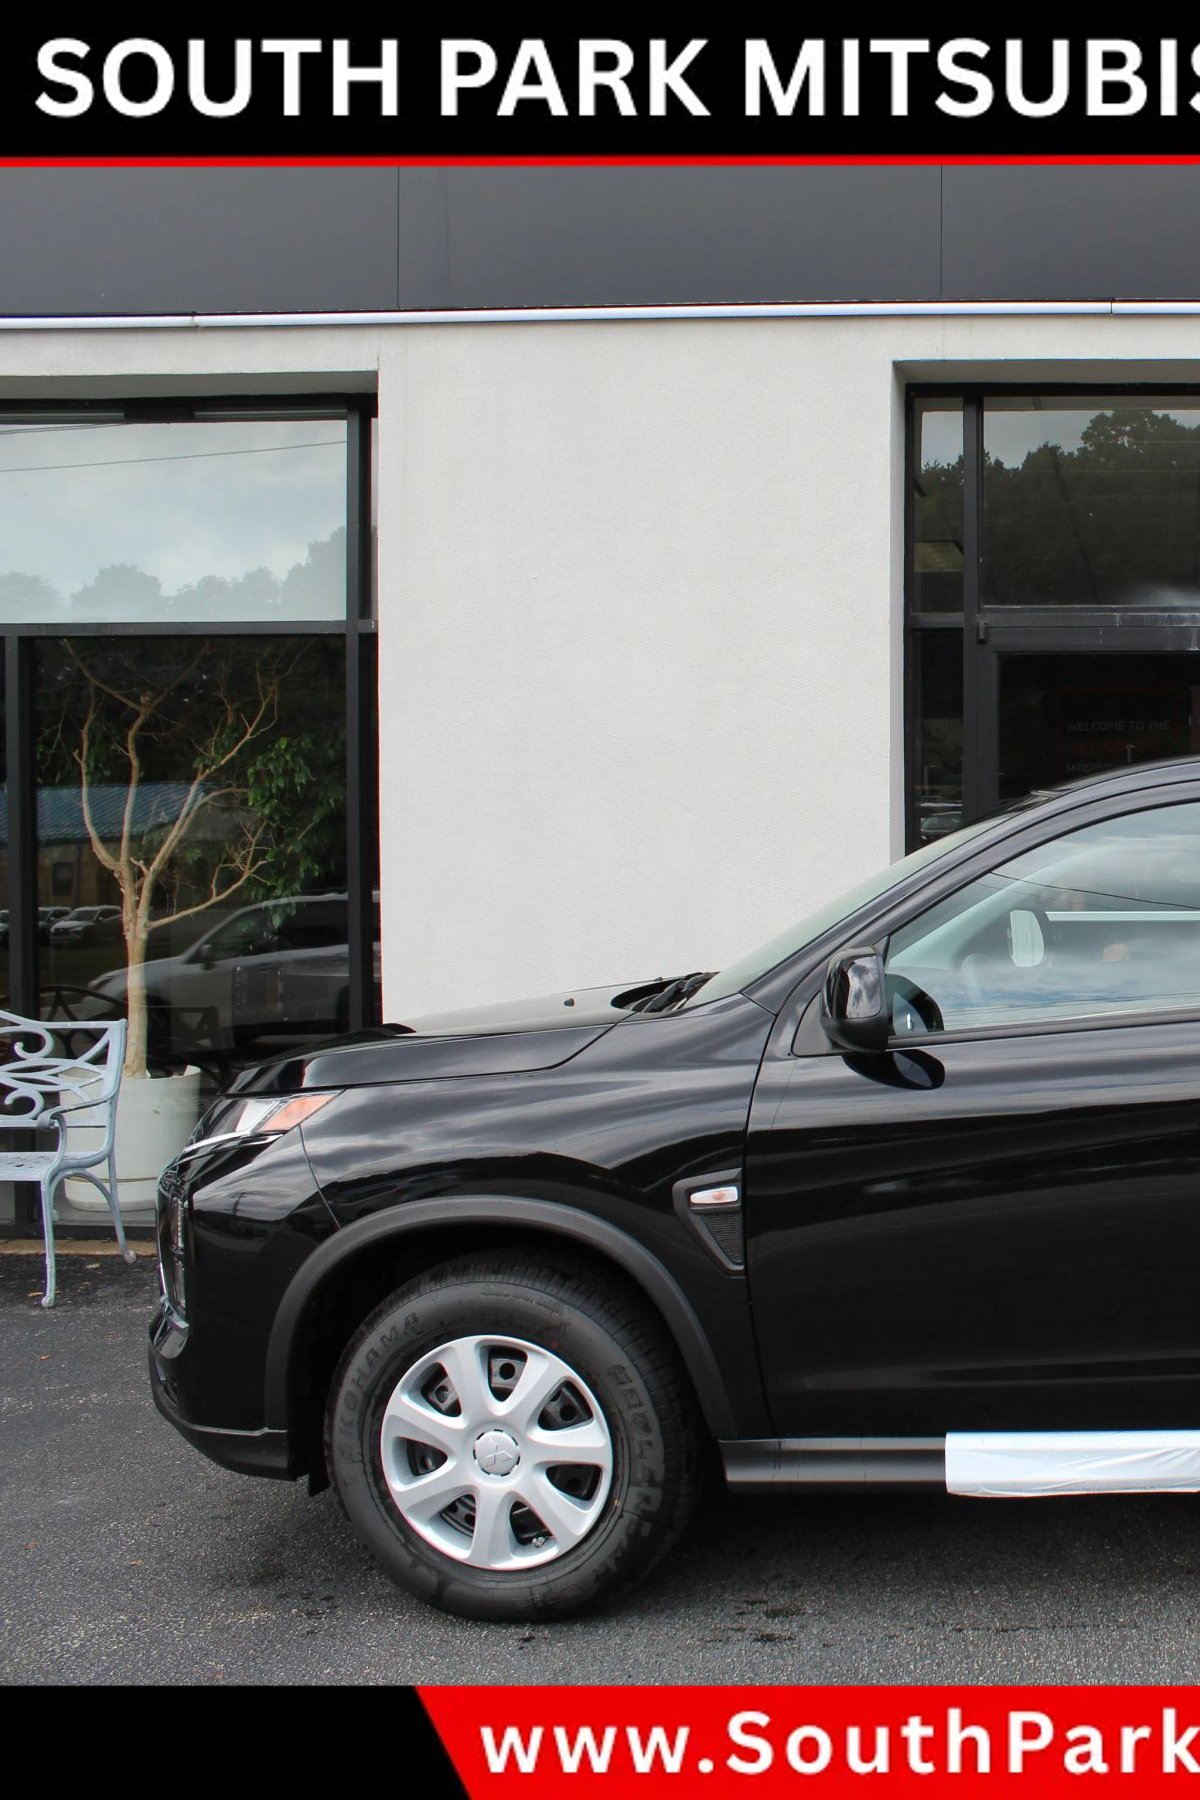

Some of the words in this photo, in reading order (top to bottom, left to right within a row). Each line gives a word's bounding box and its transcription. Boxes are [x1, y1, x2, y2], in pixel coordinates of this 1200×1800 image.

[1065, 720, 1126, 732] WELCOME
[1128, 720, 1144, 731] TO
[1147, 720, 1172, 731] THE
